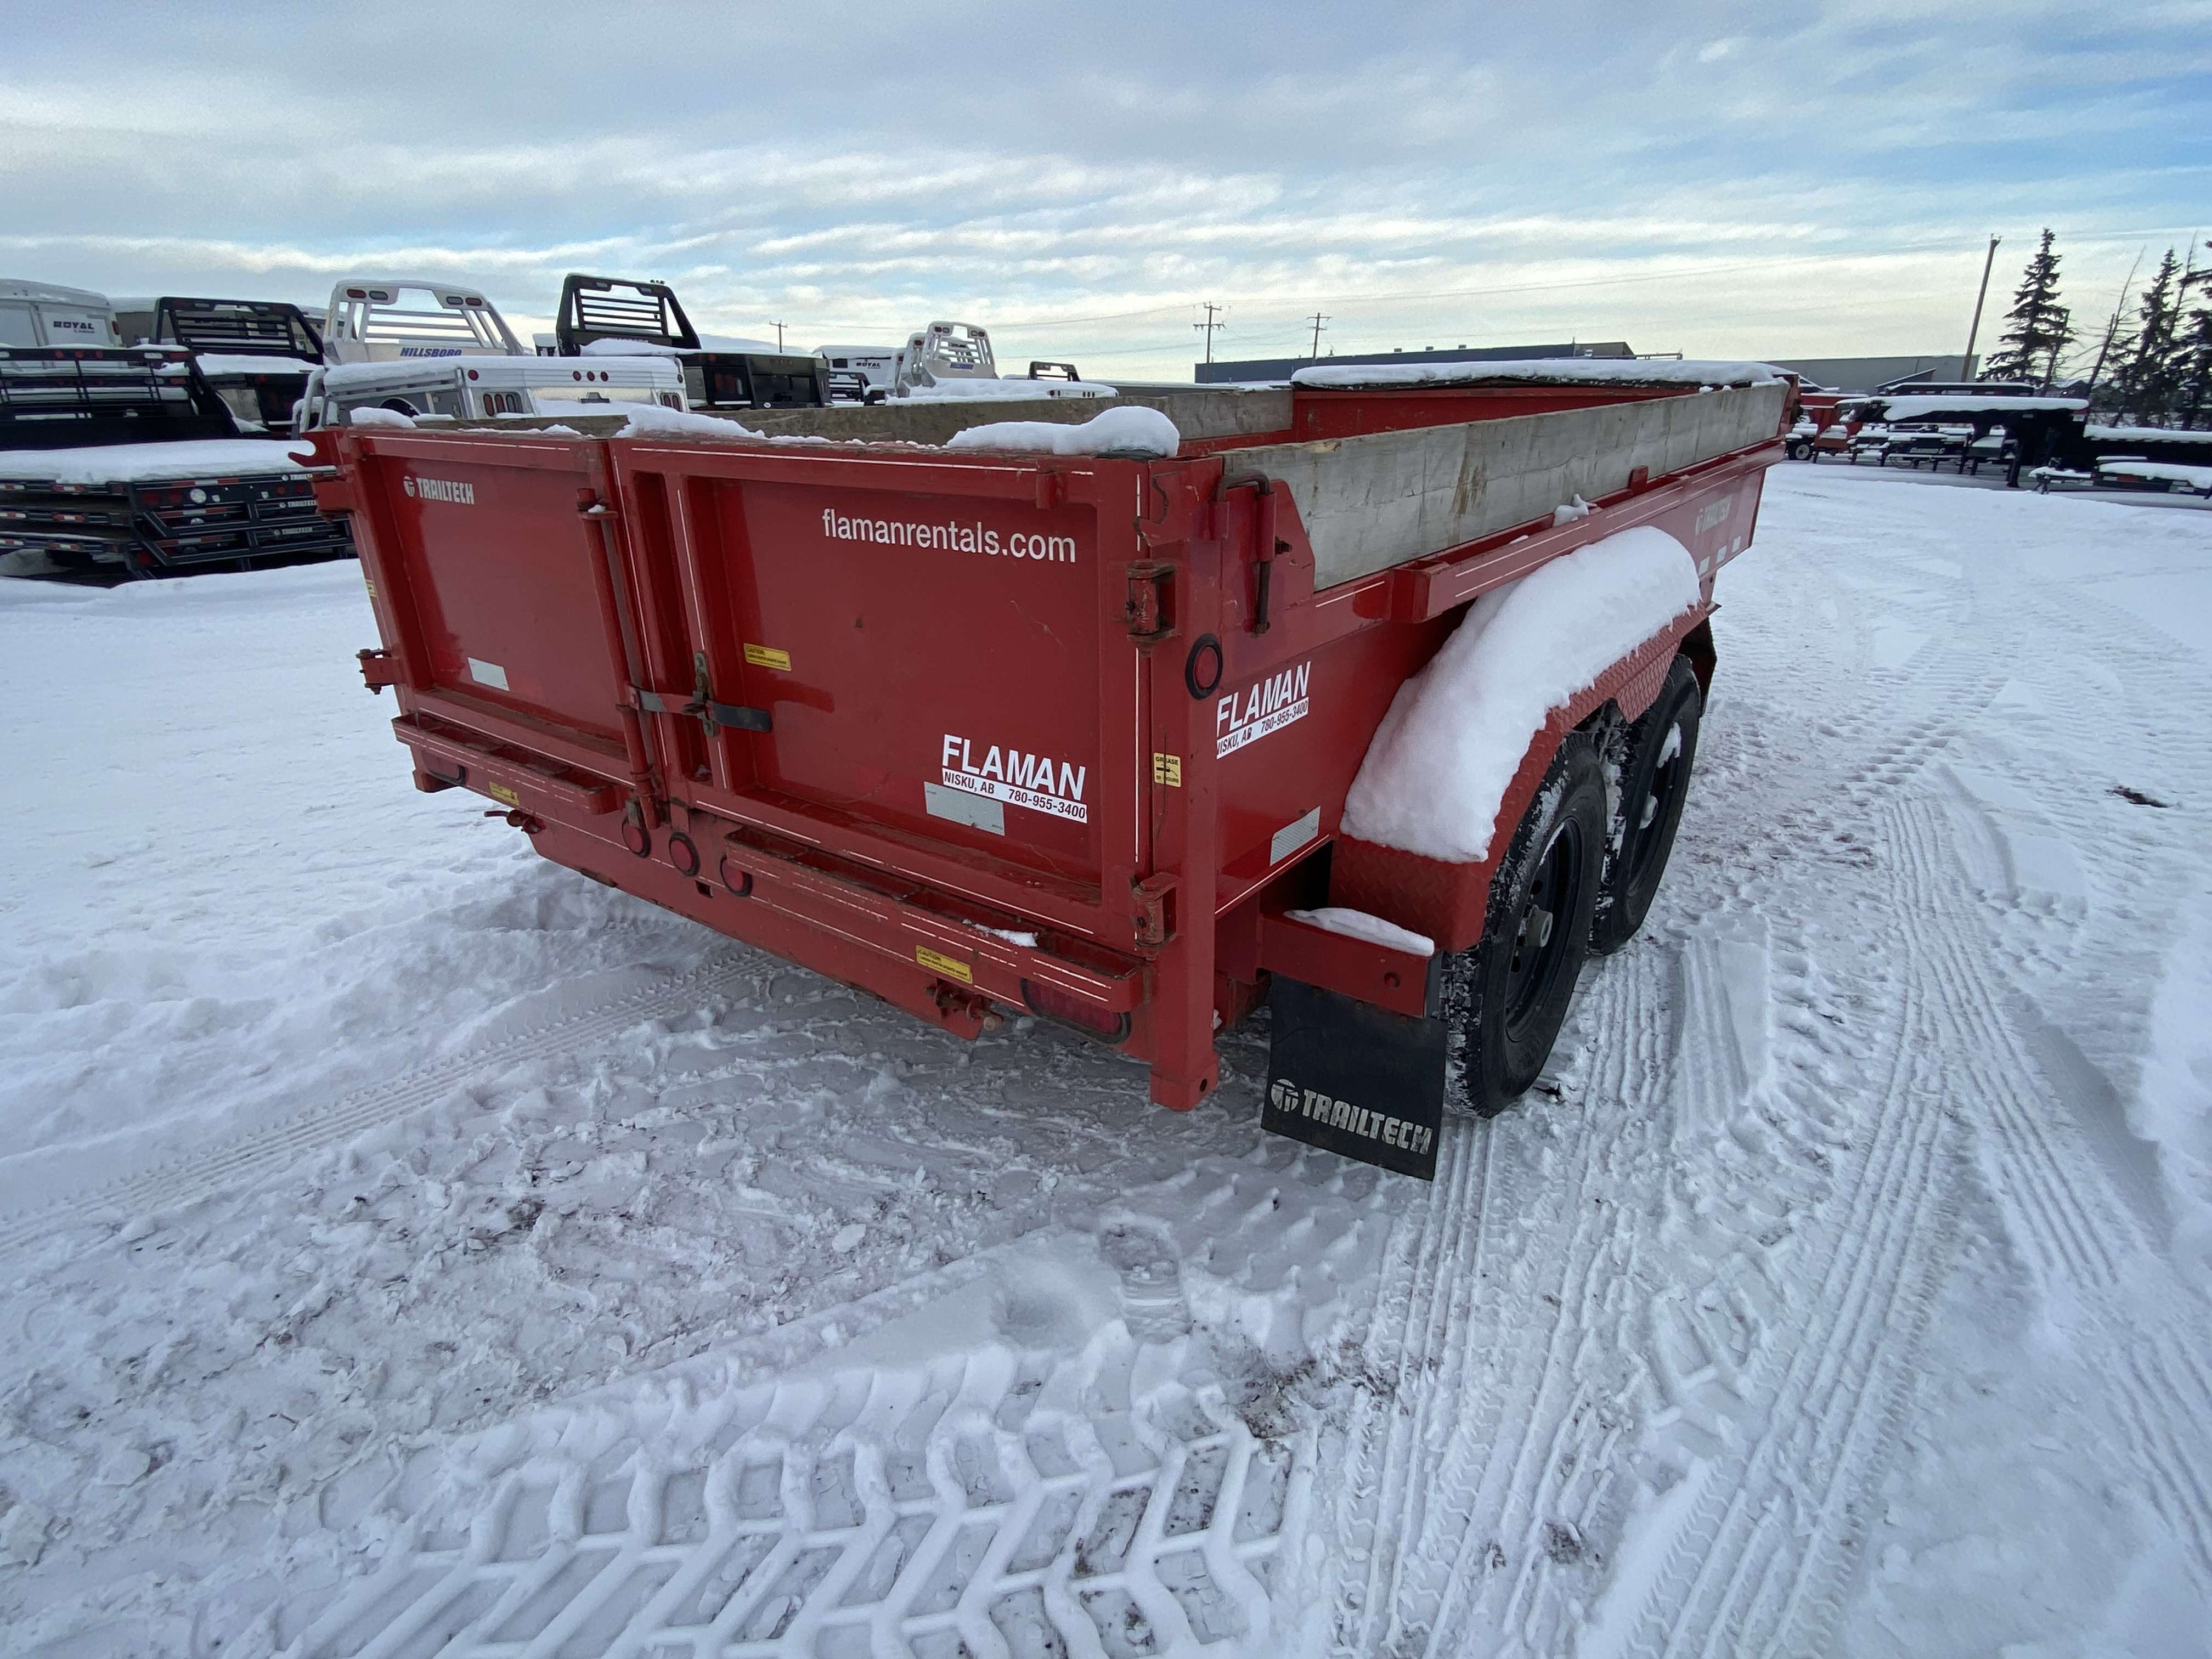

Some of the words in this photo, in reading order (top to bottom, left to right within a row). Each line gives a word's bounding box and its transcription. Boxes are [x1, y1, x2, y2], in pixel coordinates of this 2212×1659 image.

[53, 321, 95, 329] ROYAL
[400, 347, 462, 357] HILLSBORO
[416, 477, 474, 504] TRAILTECH
[822, 509, 1076, 563] flamanrentals.com
[1217, 661, 1311, 737] FLAMAN
[1241, 727, 1252, 743] AB
[1261, 701, 1308, 733] 780-955-3400
[942, 734, 1086, 801] FLAMAN
[944, 771, 977, 792] NISKU,
[980, 781, 995, 794] AB
[1008, 788, 1086, 819] 780-955-3400
[1302, 1089, 1433, 1155] TRAILTECH
